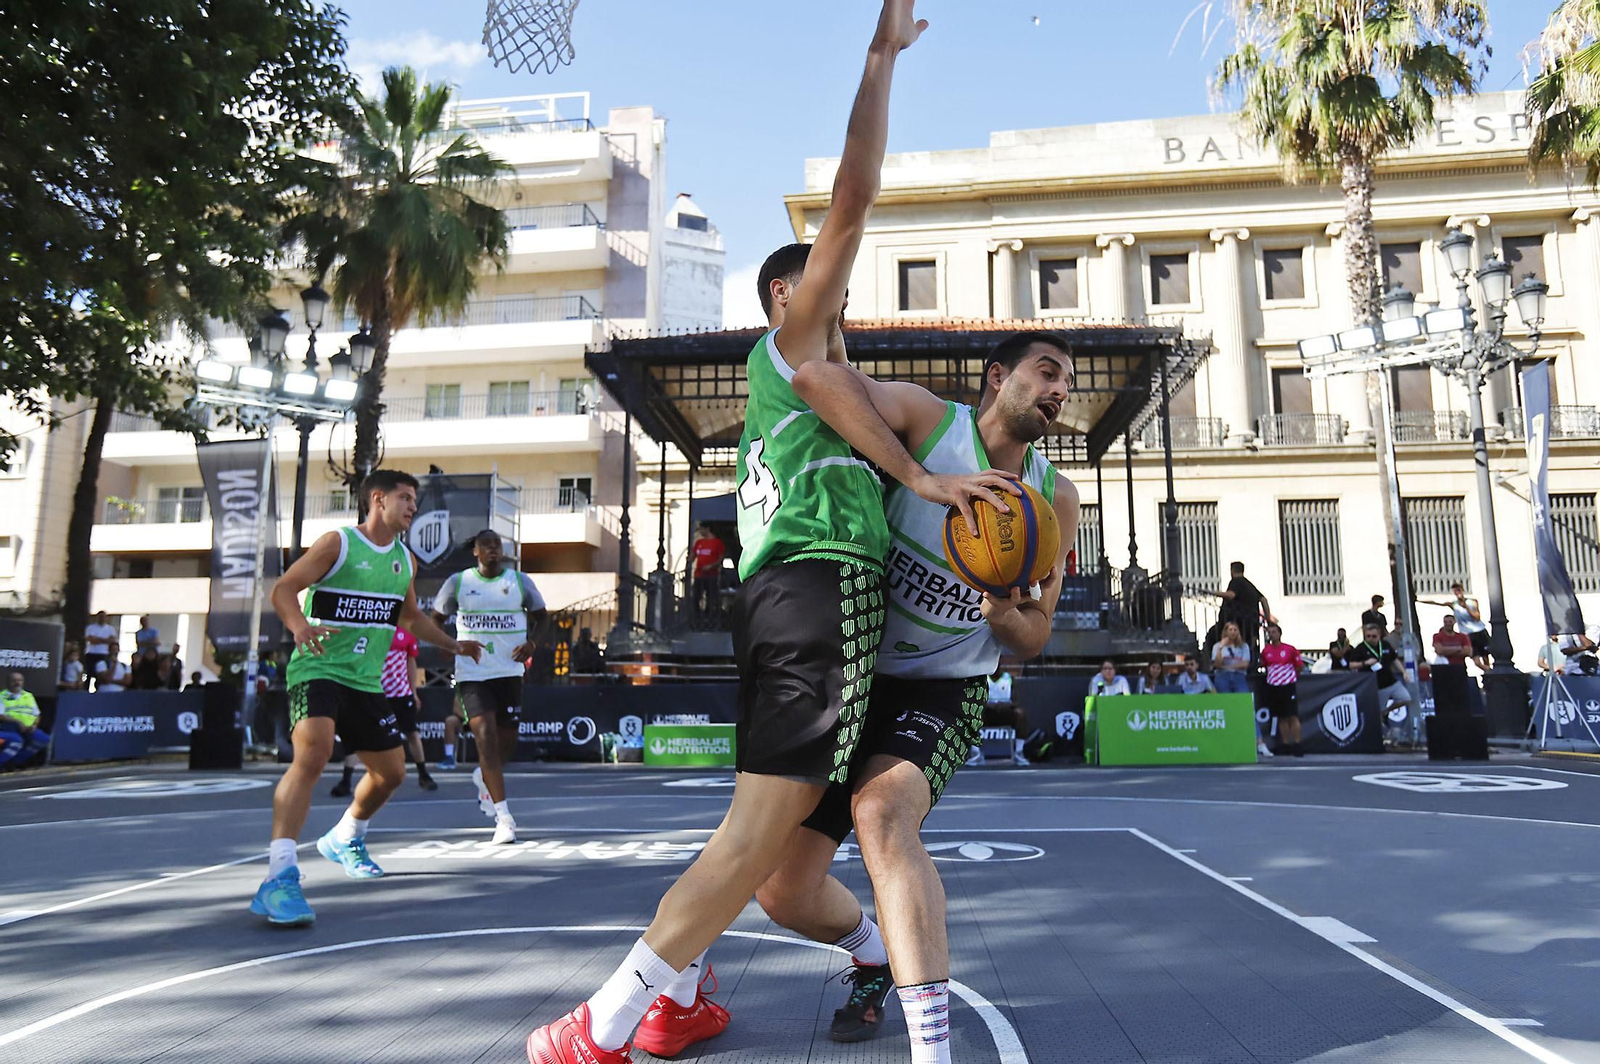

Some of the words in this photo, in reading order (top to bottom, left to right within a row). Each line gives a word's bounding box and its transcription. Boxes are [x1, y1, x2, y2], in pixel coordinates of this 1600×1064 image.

[738, 434, 782, 526] 4
[353, 636, 369, 655] 2
[87, 716, 154, 725] HERBALIFE
[1149, 709, 1225, 721] HERBALIFE
[1320, 704, 1352, 731] 100
[87, 724, 155, 734] NUTRITION
[518, 721, 564, 734] BILAMP
[1149, 719, 1226, 731] NUTRITION
[666, 737, 731, 747] HERBALIFE
[666, 745, 731, 755] NUTRITION
